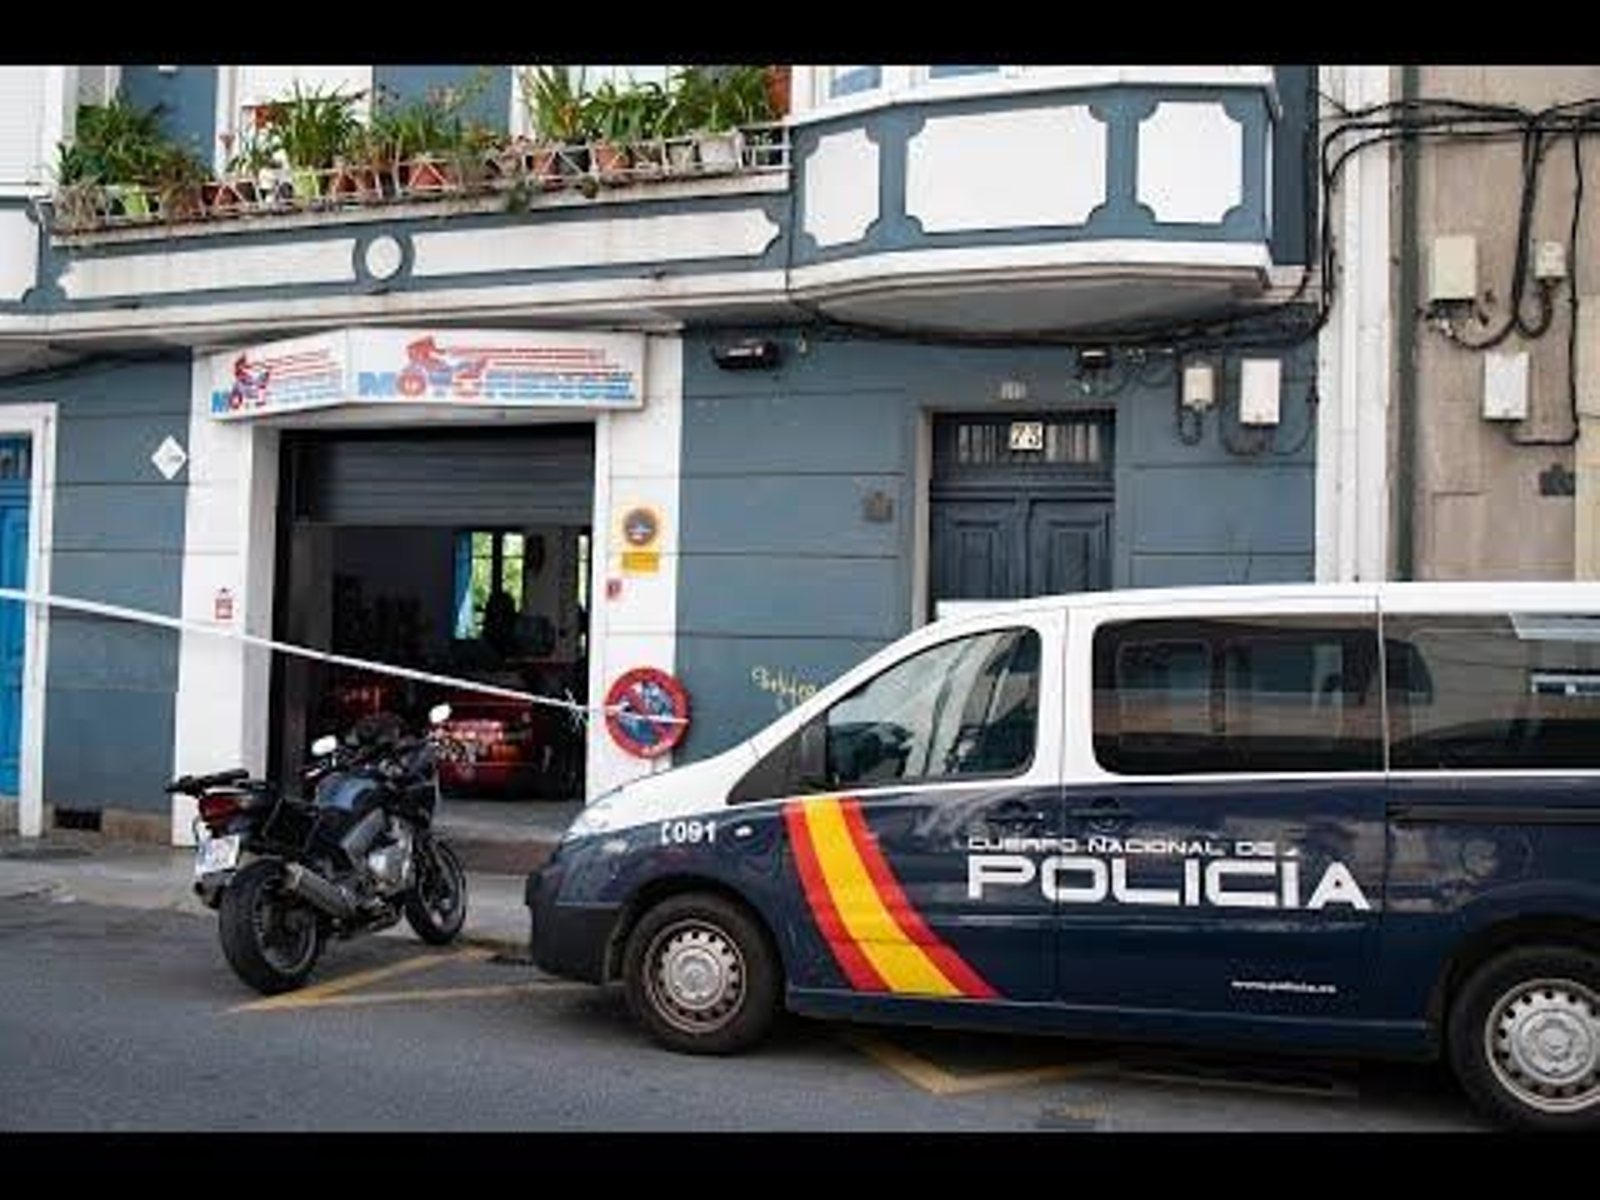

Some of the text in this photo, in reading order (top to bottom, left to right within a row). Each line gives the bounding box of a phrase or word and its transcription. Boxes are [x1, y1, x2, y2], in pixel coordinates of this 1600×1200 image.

[674, 821, 717, 843] 091
[968, 836, 1276, 856] CUERPO NACIONAL DE
[968, 848, 1372, 911] POLICÍA
